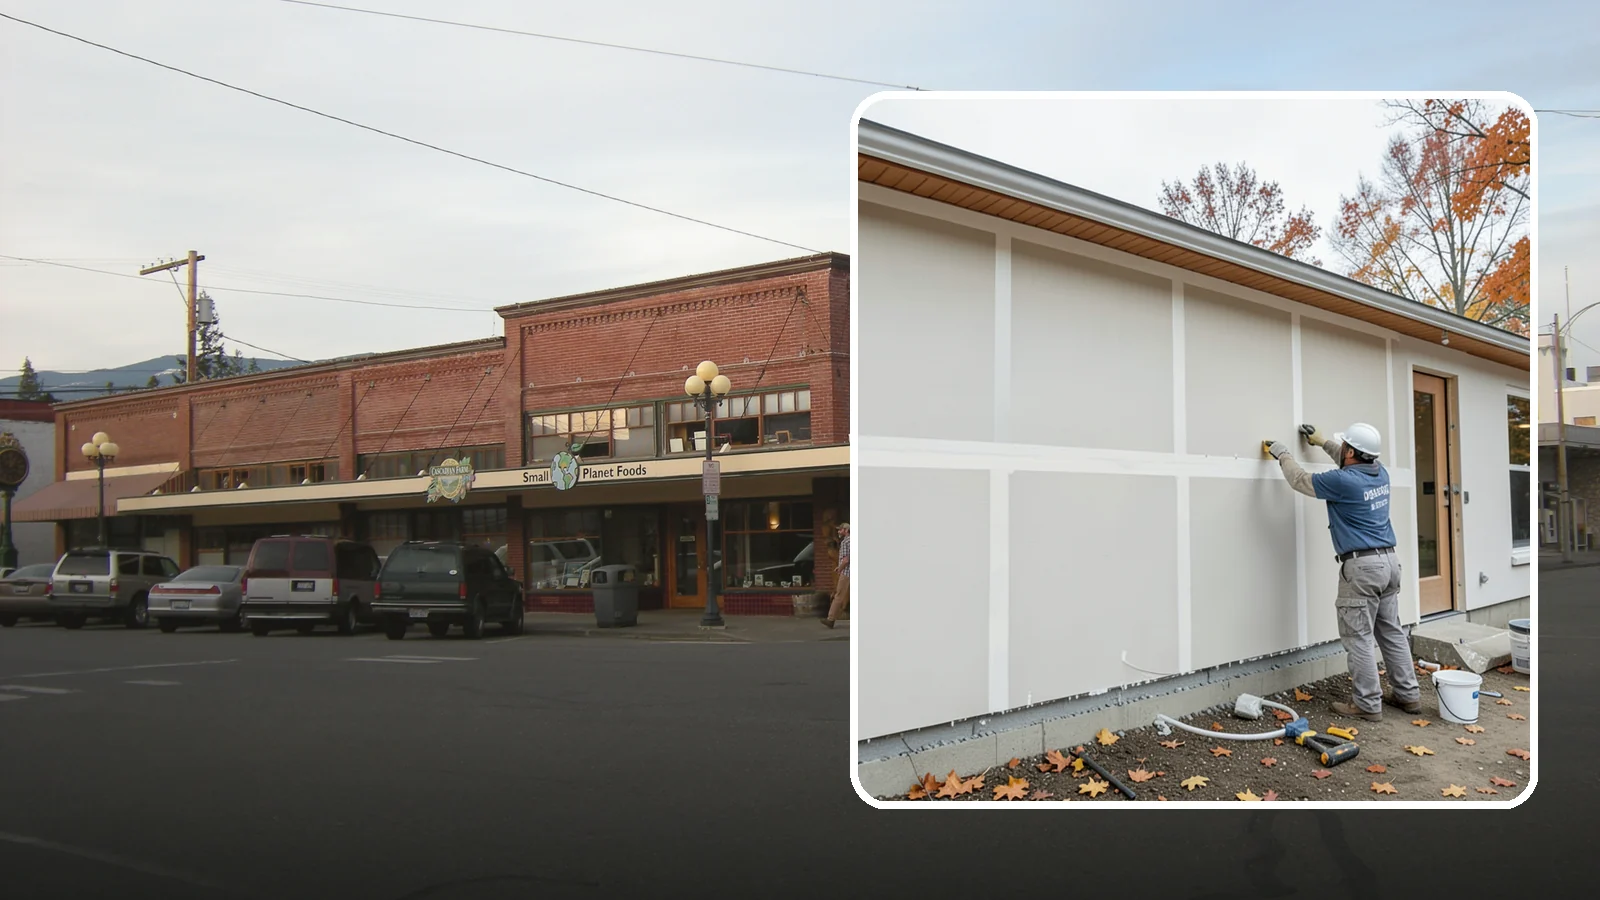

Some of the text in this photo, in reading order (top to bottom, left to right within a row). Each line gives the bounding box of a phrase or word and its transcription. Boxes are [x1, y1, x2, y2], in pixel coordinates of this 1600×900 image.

[523, 464, 647, 483] Small Planet Foods
